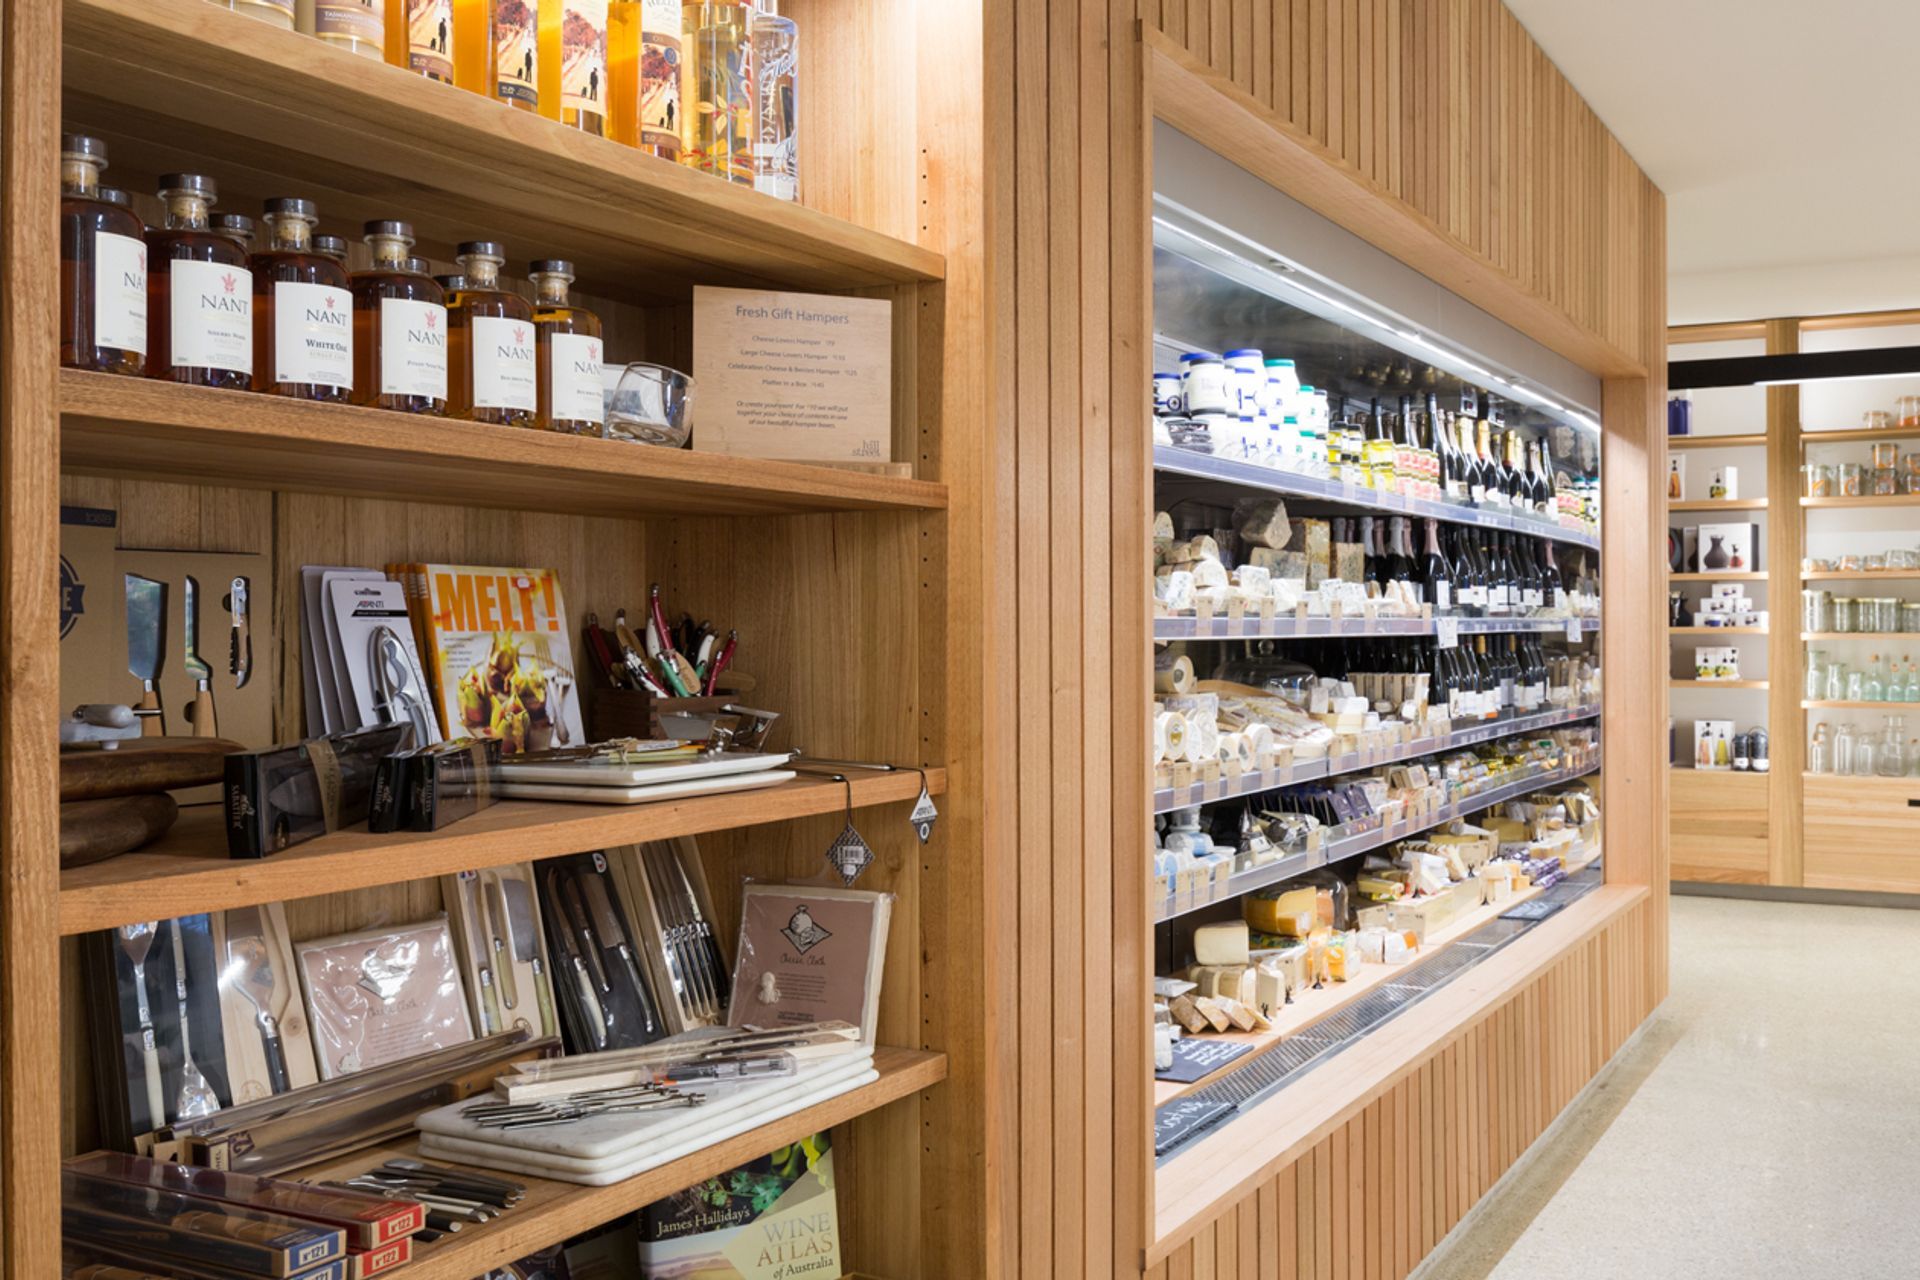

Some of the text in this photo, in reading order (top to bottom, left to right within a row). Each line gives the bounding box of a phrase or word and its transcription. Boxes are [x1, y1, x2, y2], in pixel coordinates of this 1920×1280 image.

[201, 294, 249, 315] NANT
[736, 305, 849, 325] Fresh Gift Hampers
[306, 309, 347, 326] NANT
[305, 338, 336, 351] WHITE
[435, 573, 560, 632] MELT!
[656, 1206, 750, 1238] James Halliday's
[763, 1212, 831, 1243] WINE
[757, 1233, 833, 1267] ATLAS
[773, 1256, 834, 1280] of Australia
